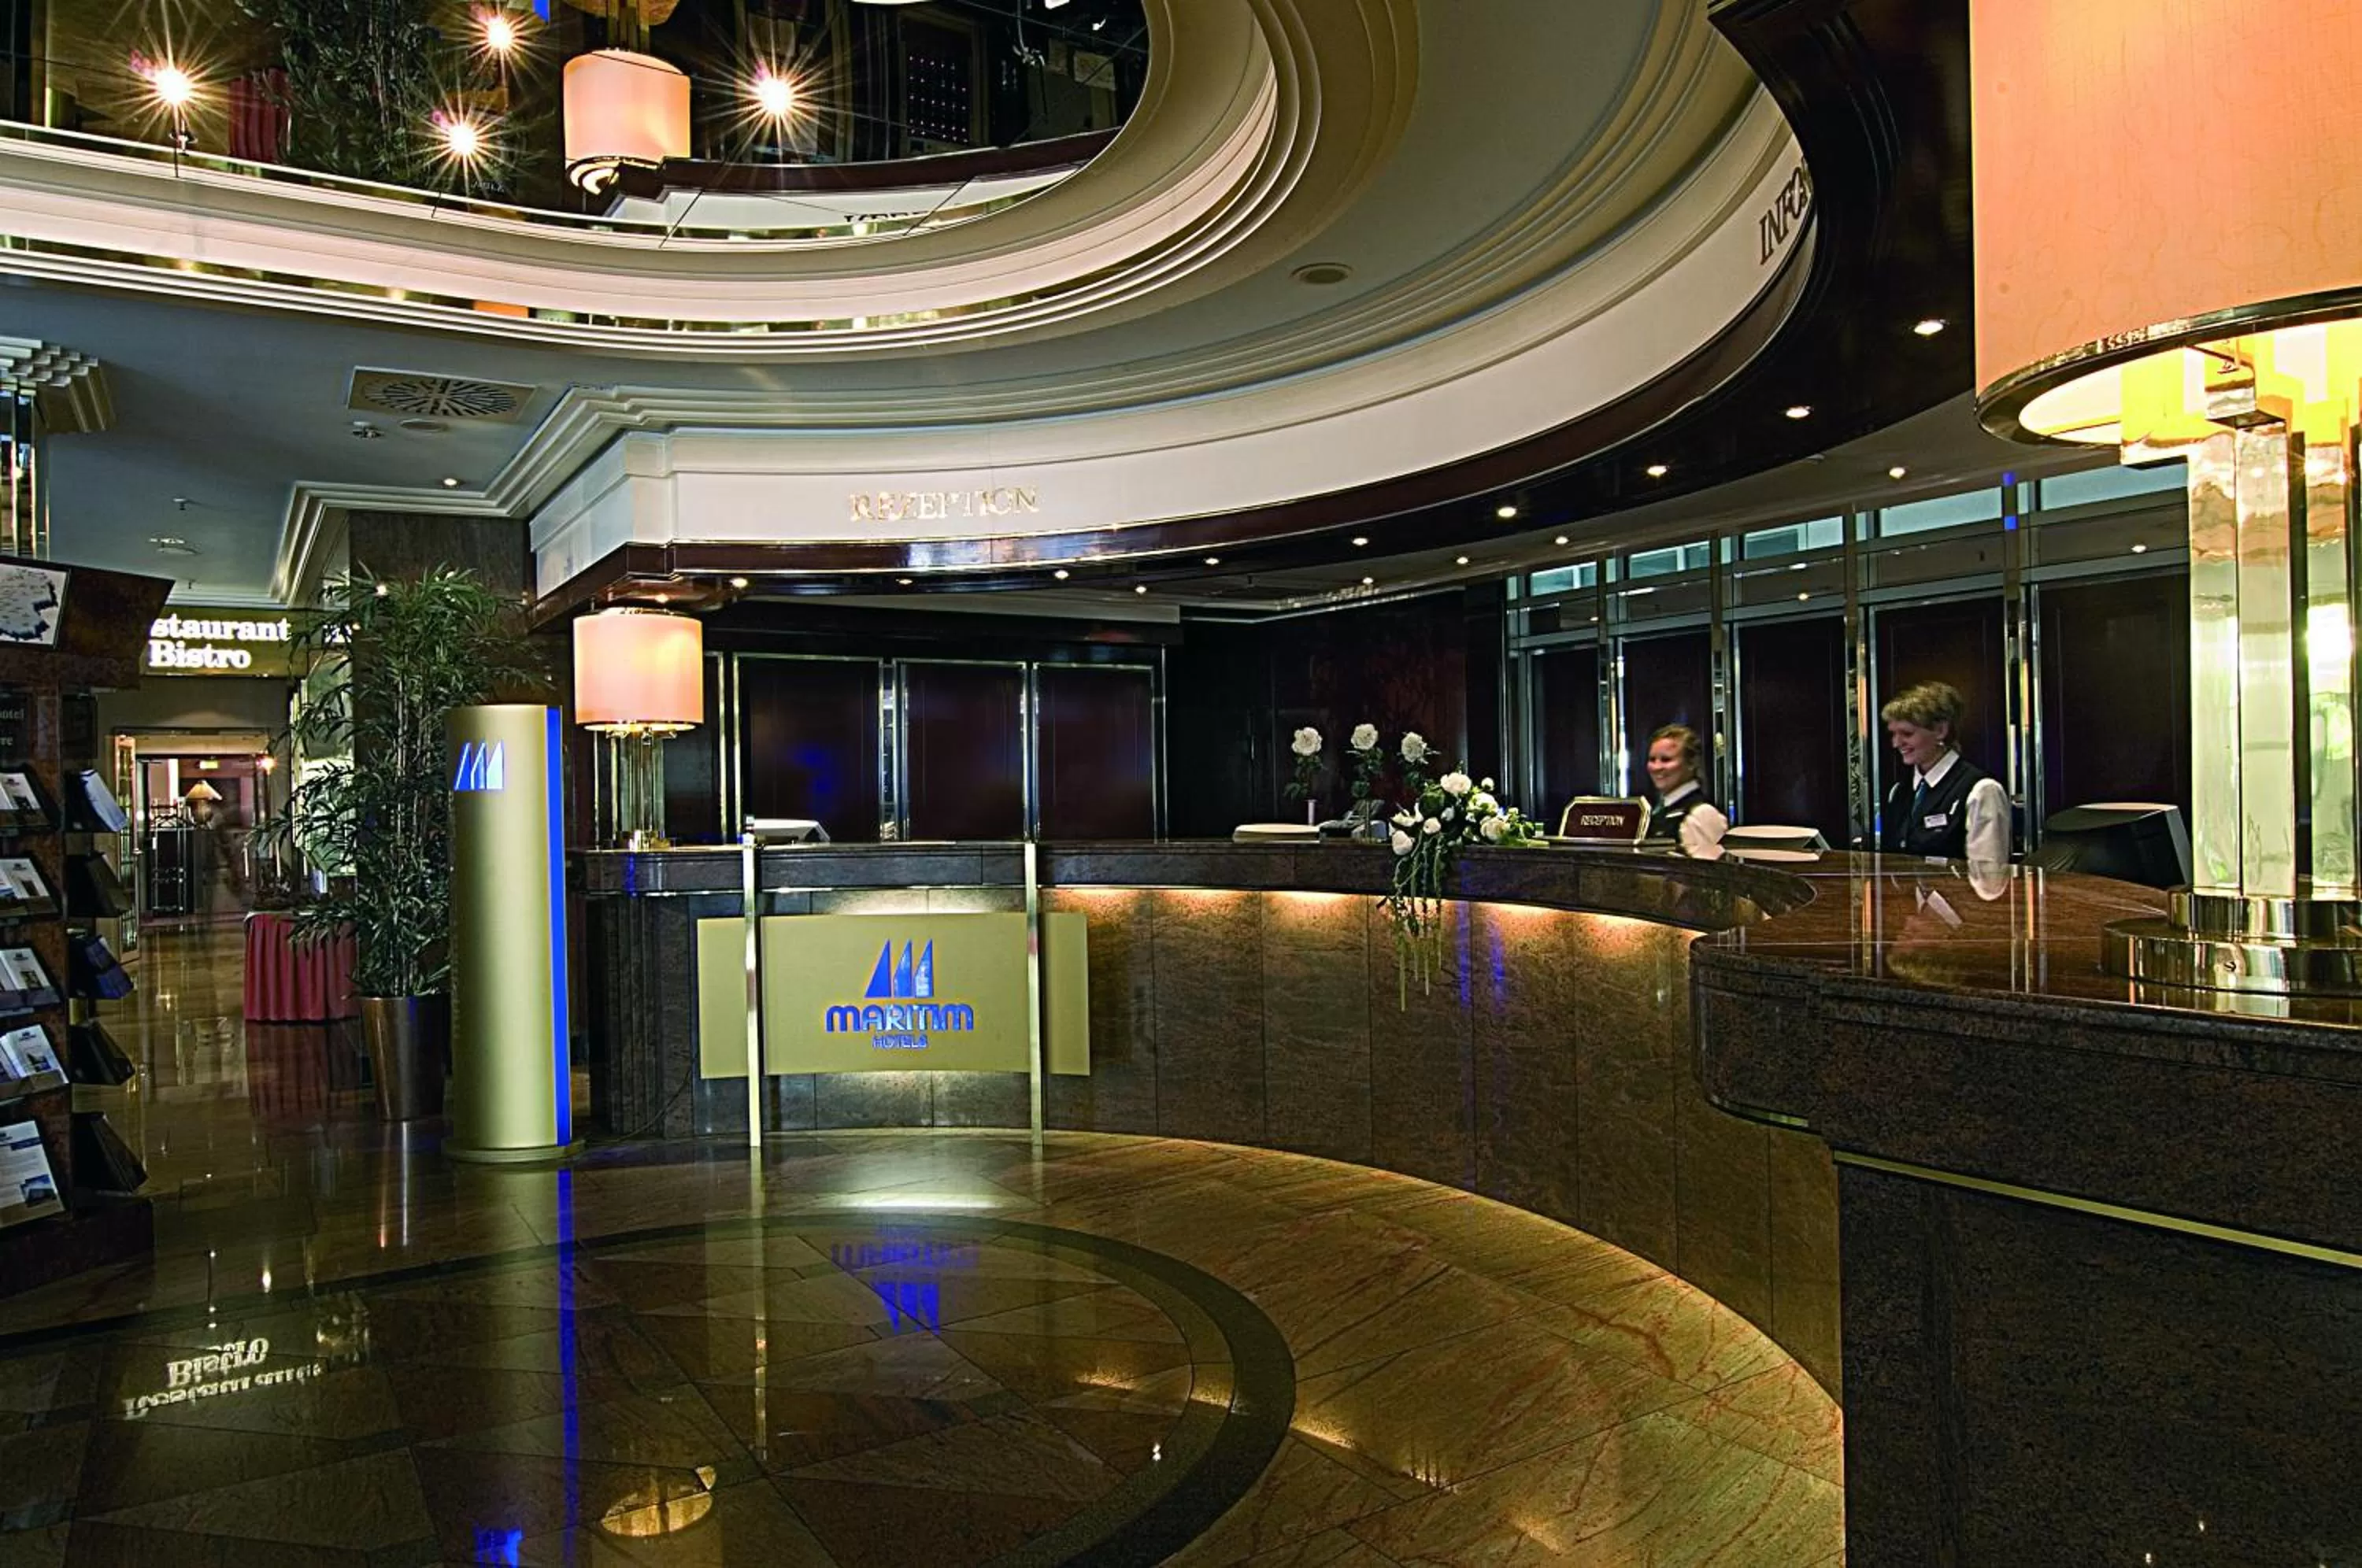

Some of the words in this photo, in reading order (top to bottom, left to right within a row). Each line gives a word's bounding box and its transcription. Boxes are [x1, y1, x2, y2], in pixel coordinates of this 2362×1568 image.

[849, 487, 1040, 522] REZEPTION
[147, 639, 252, 668] Bistro
[1581, 815, 1625, 827] RECEPTION
[824, 1004, 975, 1033] MARITIM
[872, 1034, 928, 1049] HOTELS
